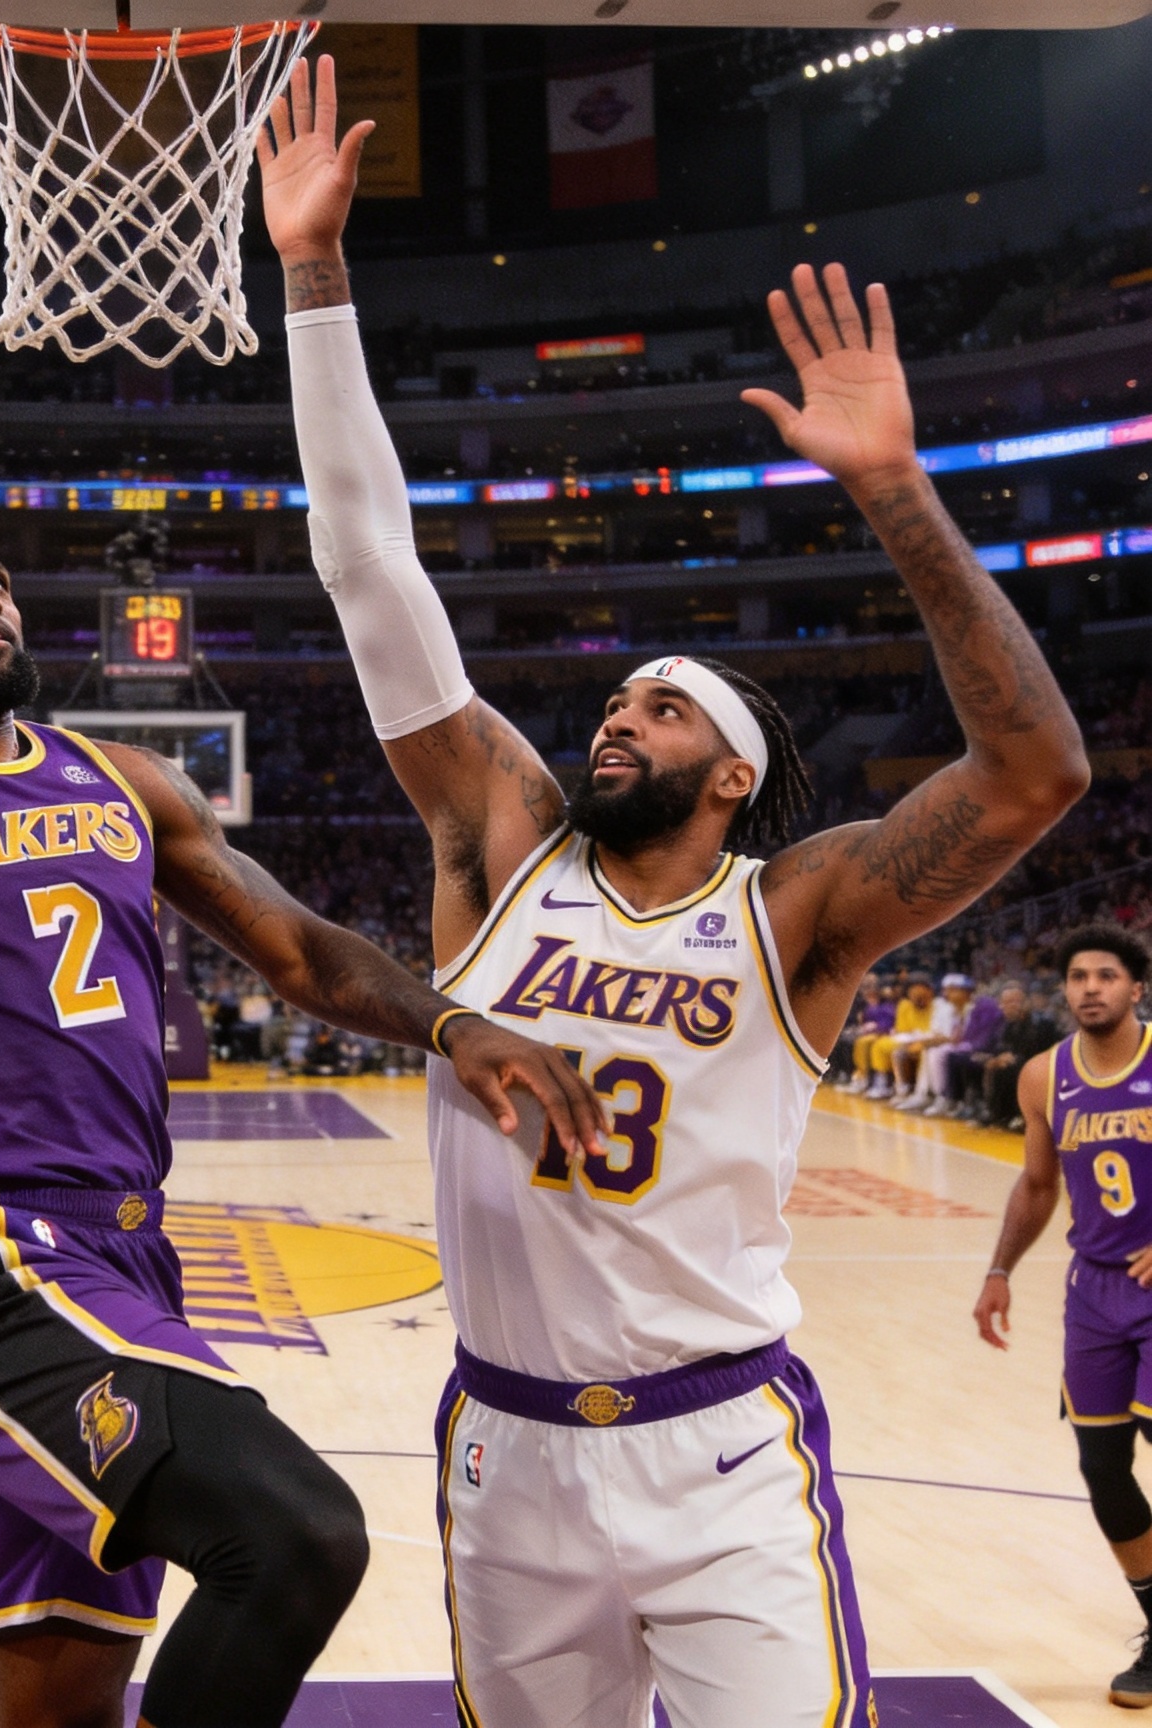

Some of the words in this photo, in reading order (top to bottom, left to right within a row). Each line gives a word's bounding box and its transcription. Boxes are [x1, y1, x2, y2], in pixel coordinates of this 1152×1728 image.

[136, 617, 176, 659] 19
[22, 882, 127, 1029] 2
[489, 934, 742, 1051] LAKERS
[1093, 1150, 1136, 1217] 9
